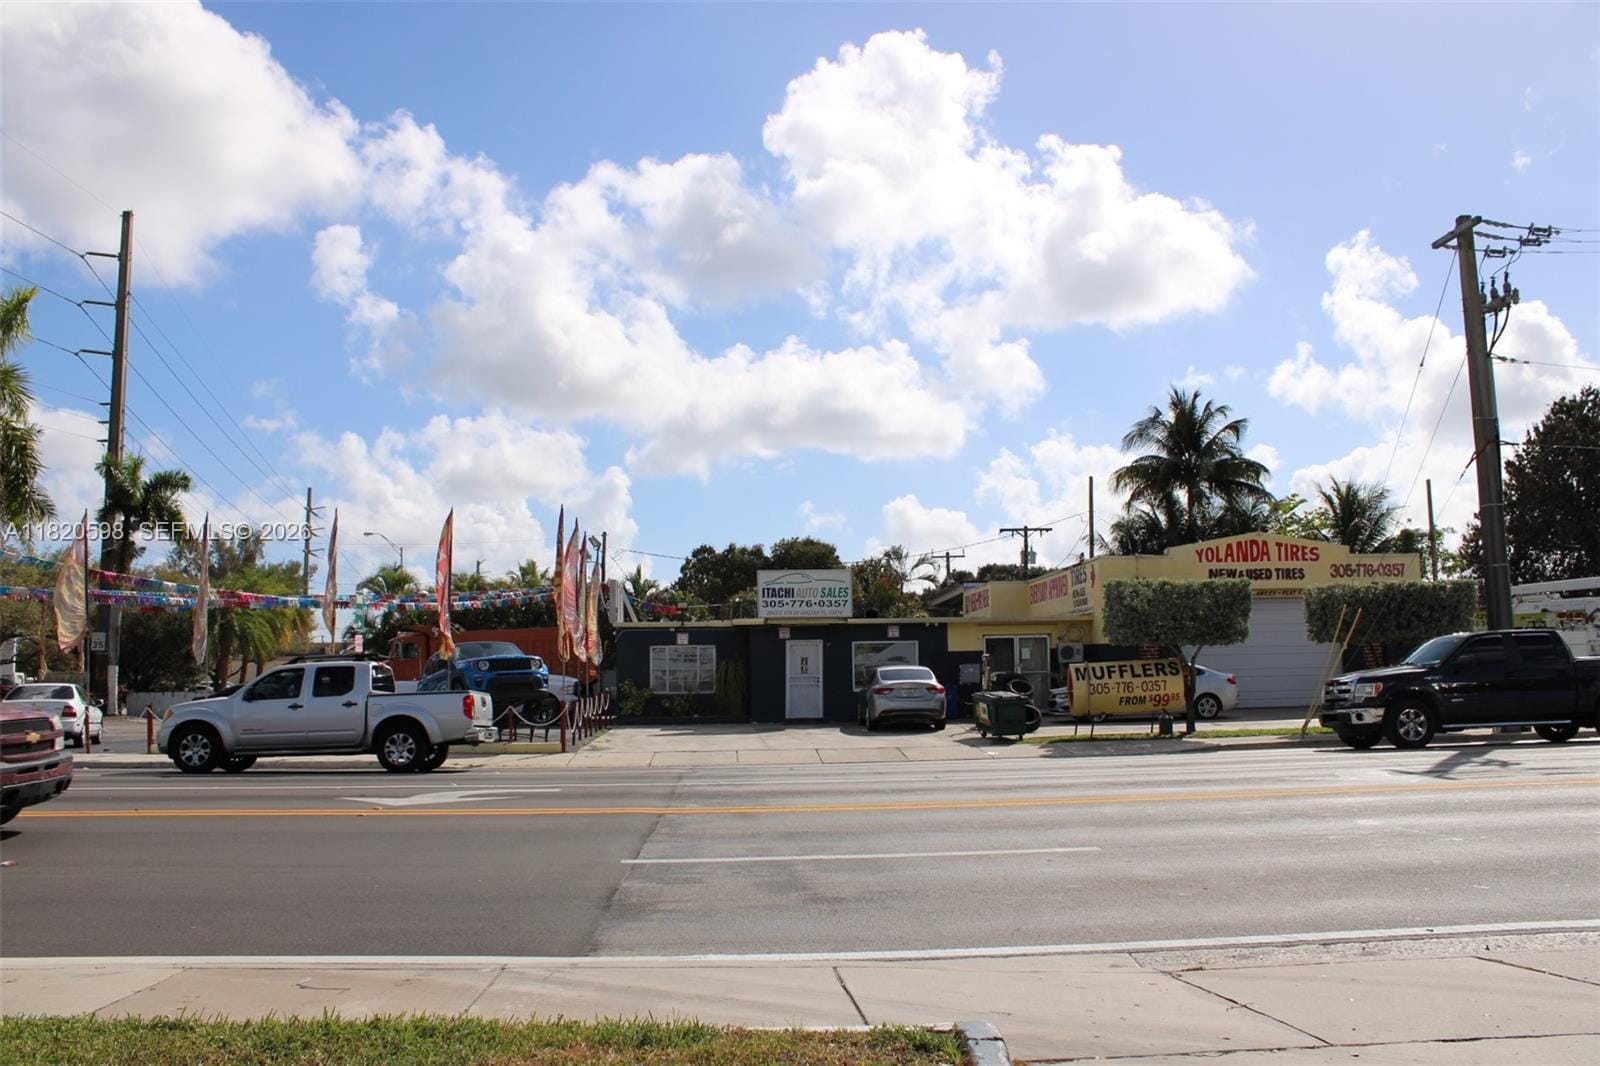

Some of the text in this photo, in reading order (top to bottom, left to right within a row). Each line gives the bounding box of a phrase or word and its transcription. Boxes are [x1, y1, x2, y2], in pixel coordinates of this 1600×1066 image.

[1195, 539, 1320, 563] YOLANDA TIRES
[1208, 567, 1306, 581] NEW & USED TIRES
[1329, 562, 1405, 579] 305-776-0357
[761, 587, 849, 599] ITACHI AUTO SALES
[92, 640, 105, 649] 35
[1074, 662, 1181, 681] MUFFLERS
[1089, 680, 1168, 696] 305-776-0357
[1119, 695, 1147, 706] FROM
